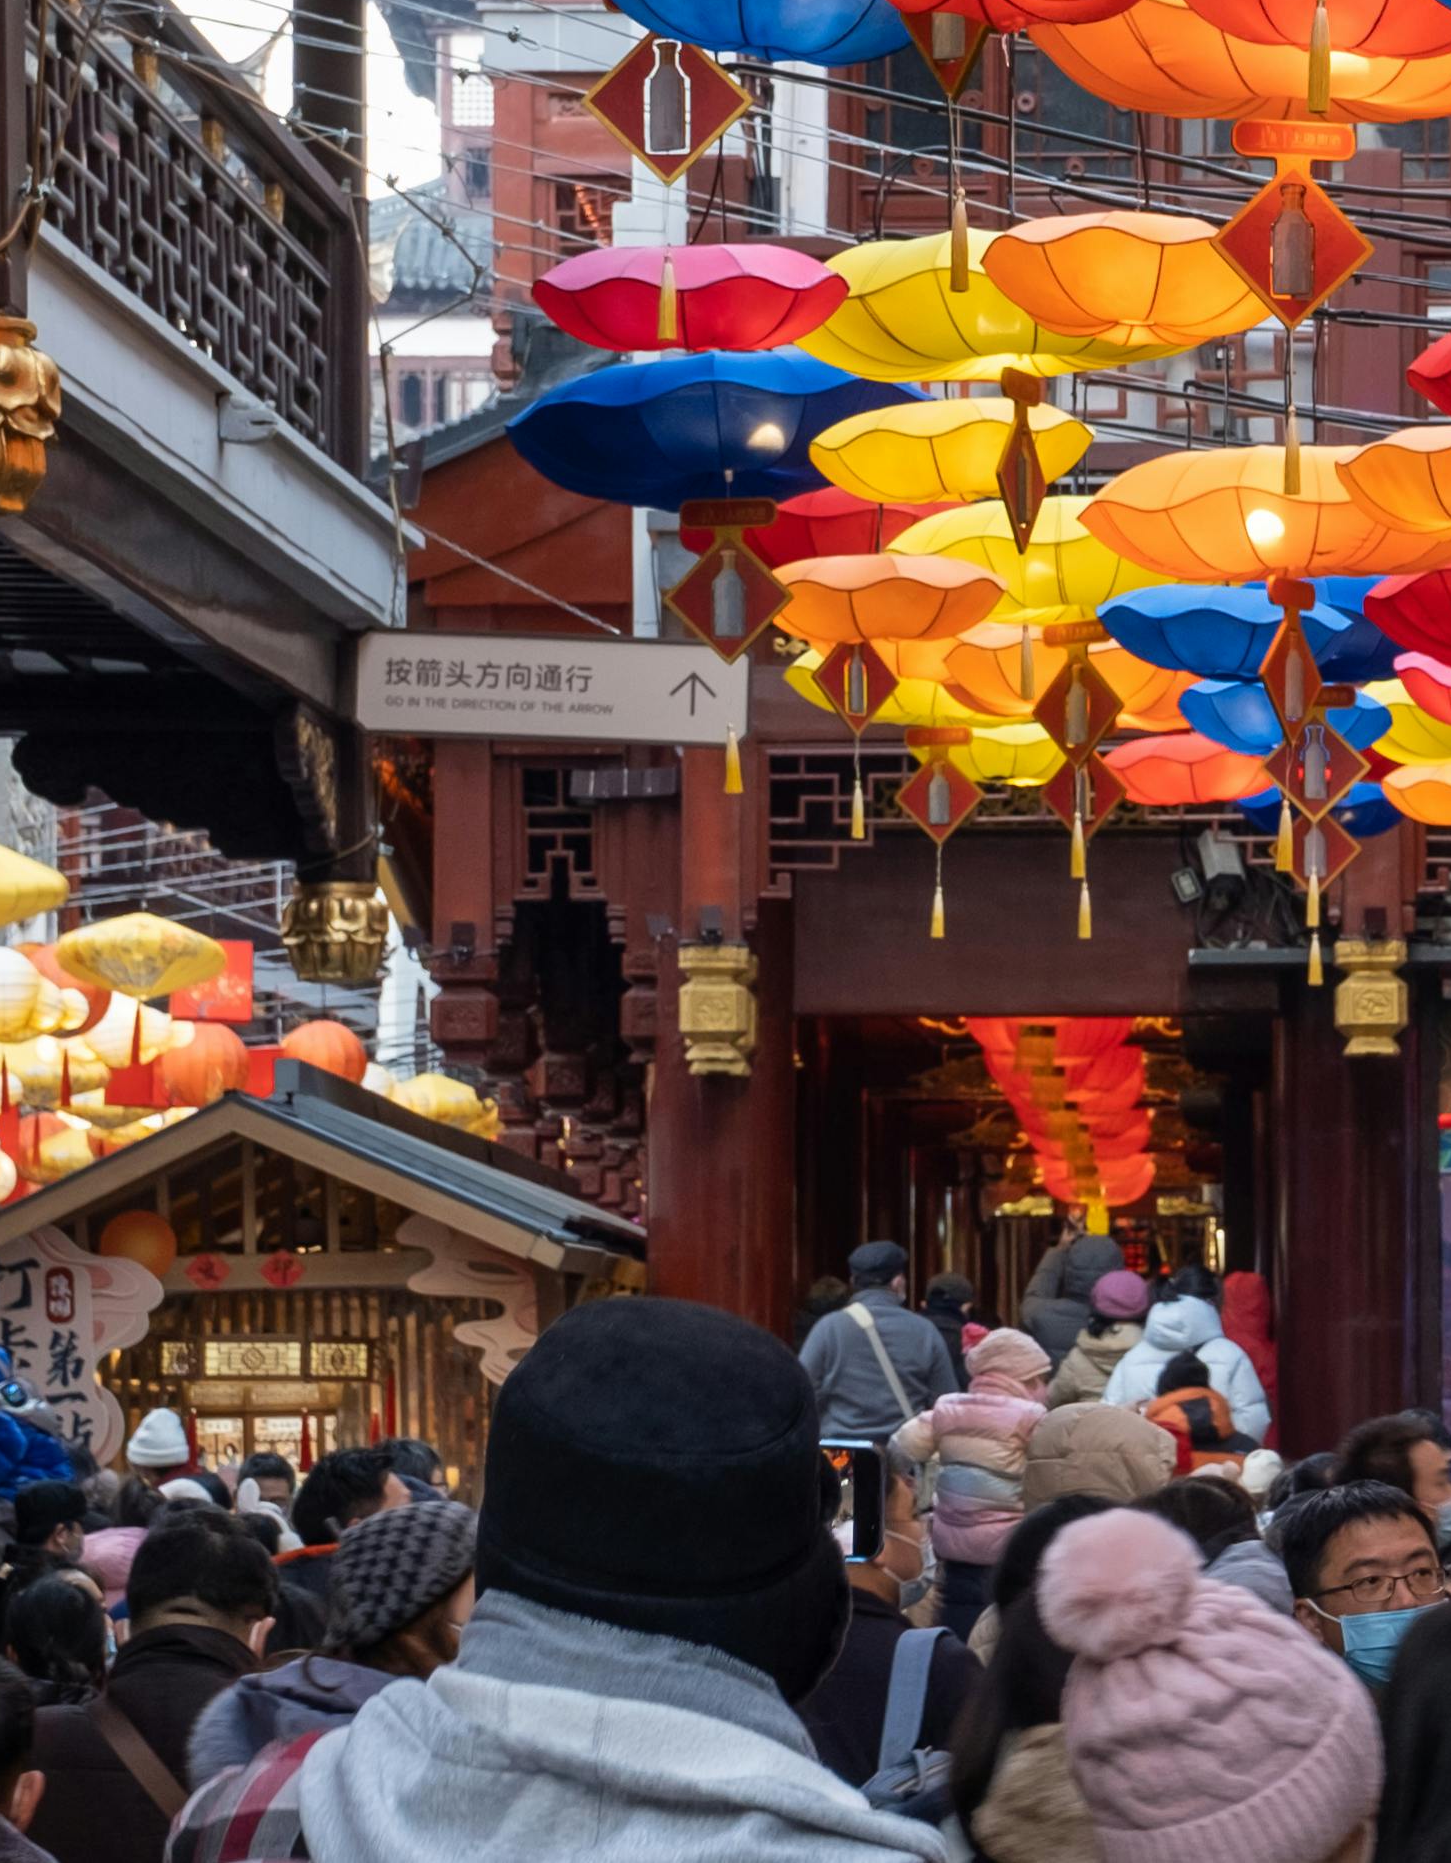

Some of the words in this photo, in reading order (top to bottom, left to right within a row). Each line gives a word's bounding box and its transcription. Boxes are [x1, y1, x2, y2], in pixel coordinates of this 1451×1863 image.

[385, 657, 593, 693] 按箭头方向通行
[385, 695, 403, 707] GO
[407, 697, 420, 708] IN
[425, 697, 446, 709] THE
[452, 698, 516, 712] DIRECTION
[520, 701, 536, 712] OF
[542, 702, 564, 714] THE
[568, 704, 613, 715] ARROW
